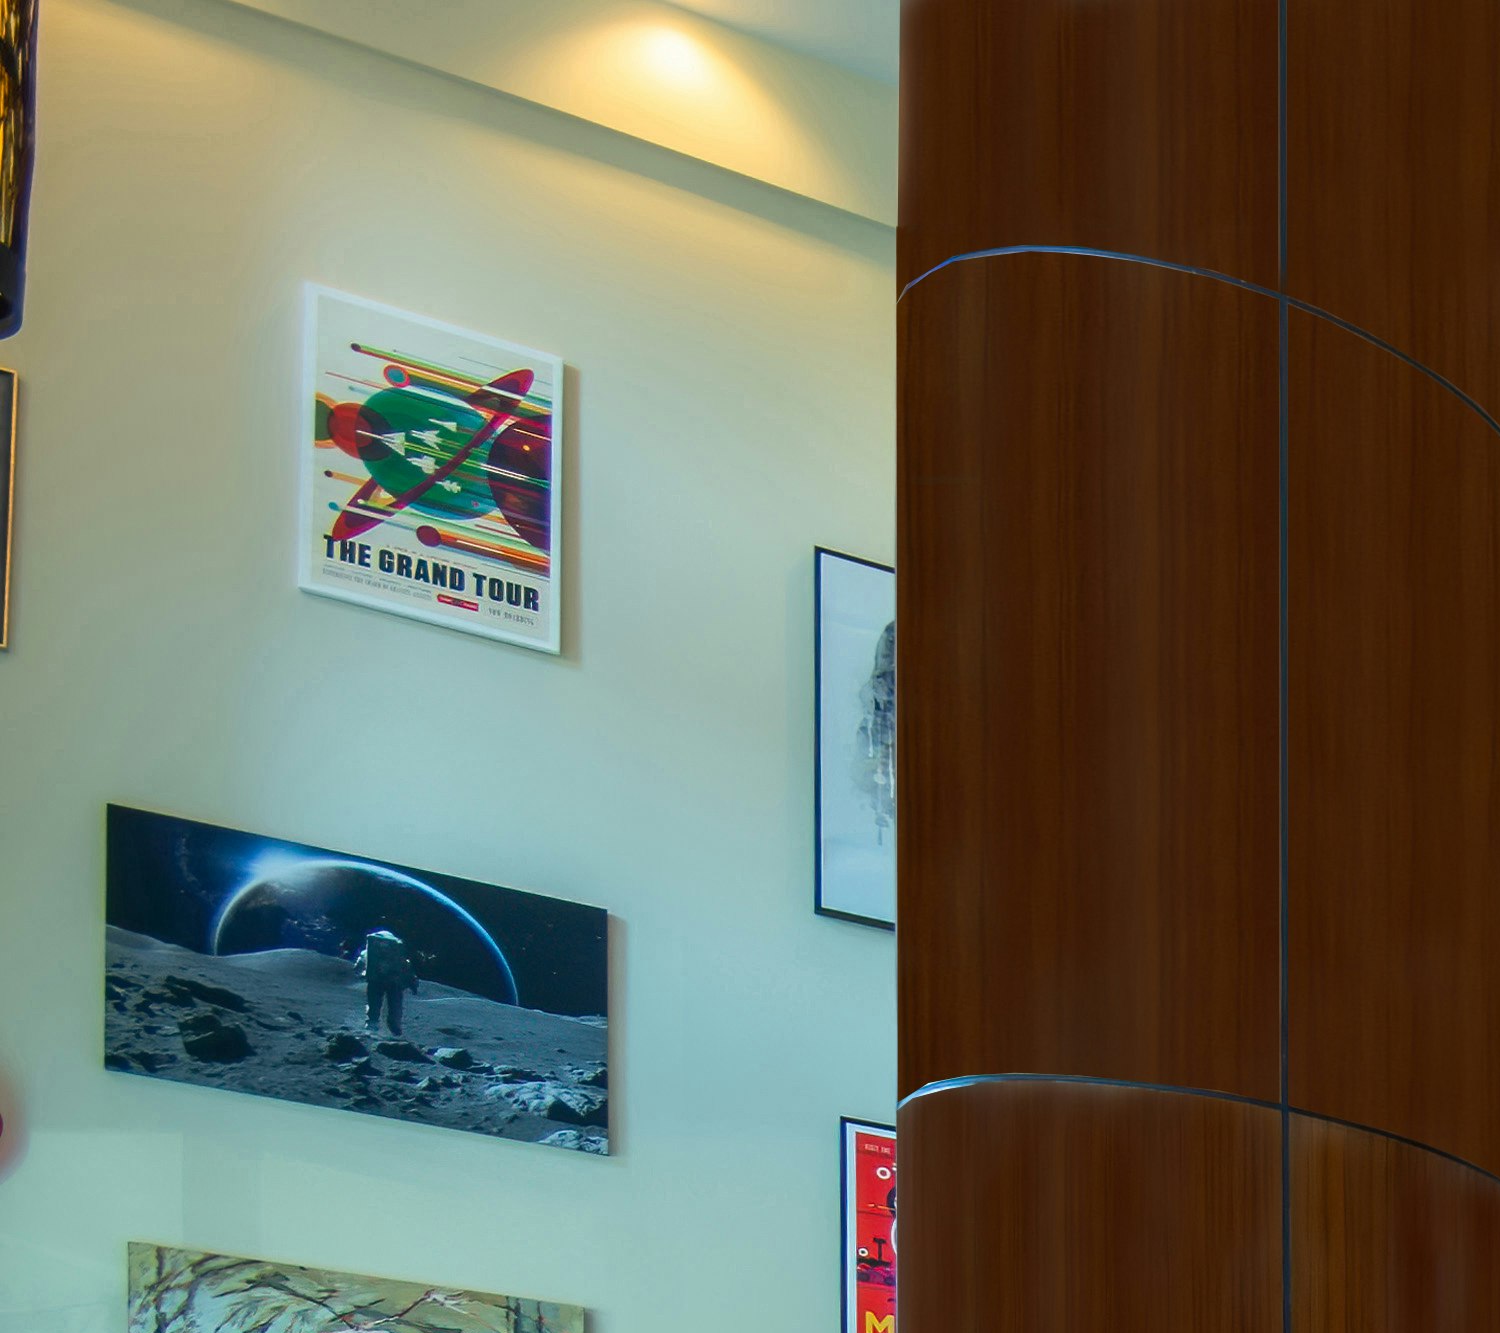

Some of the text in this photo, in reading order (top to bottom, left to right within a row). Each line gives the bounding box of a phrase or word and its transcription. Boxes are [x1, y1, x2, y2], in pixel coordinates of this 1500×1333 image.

[323, 534, 371, 568] THE
[378, 549, 465, 592] GRAND
[472, 572, 539, 612] TOUR
